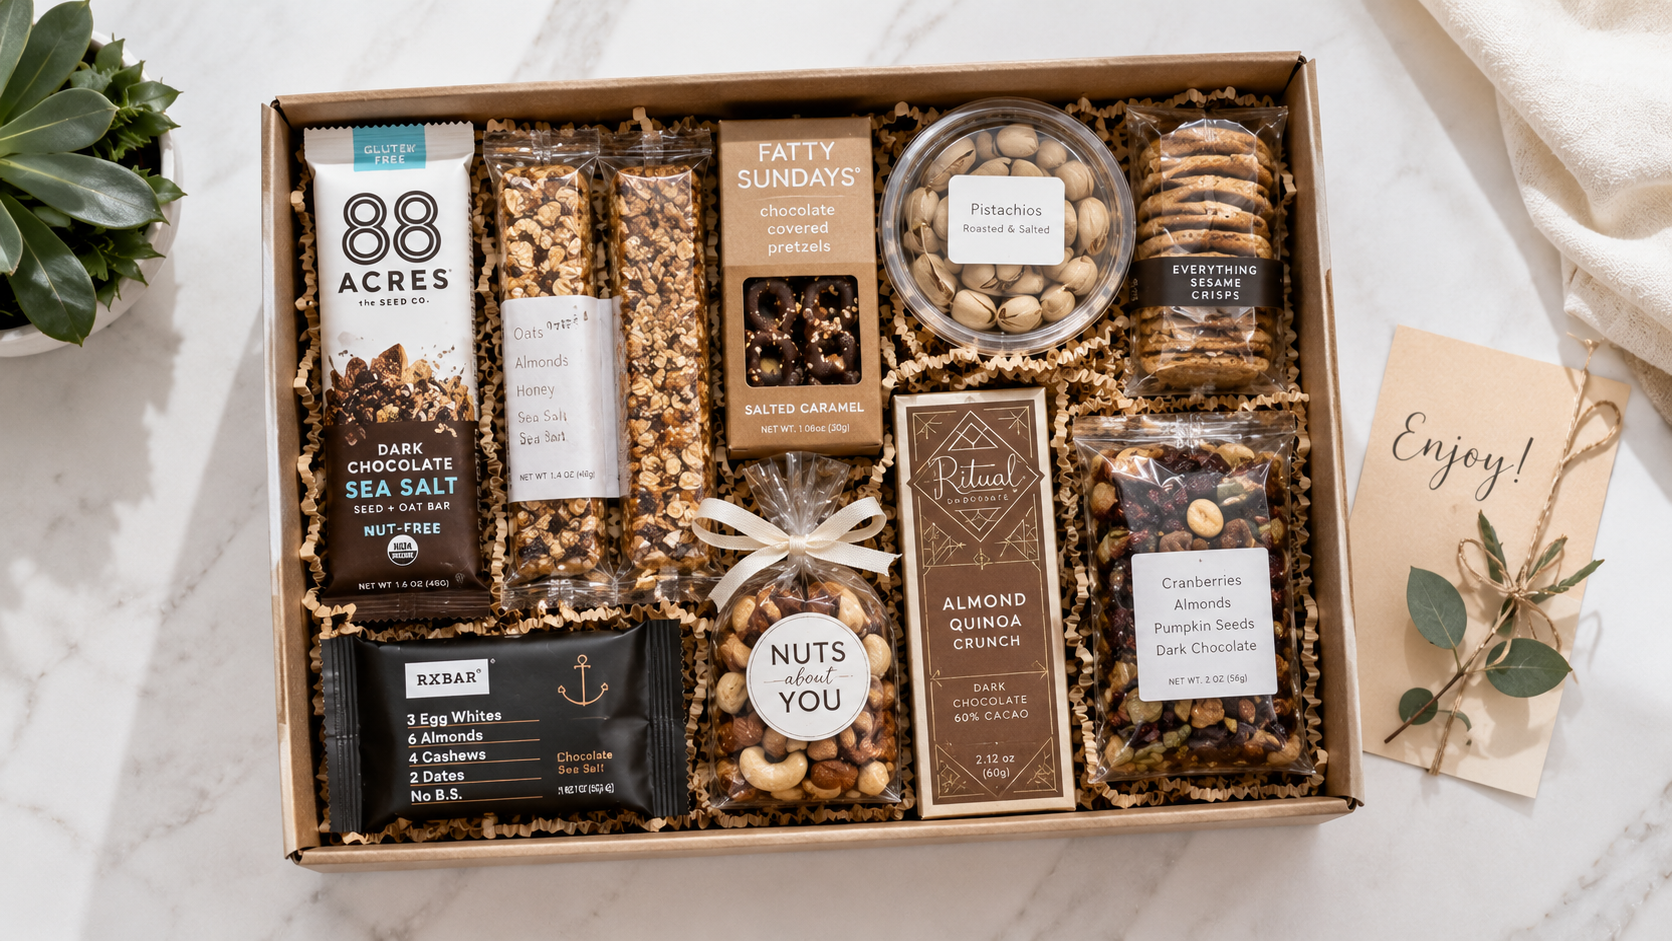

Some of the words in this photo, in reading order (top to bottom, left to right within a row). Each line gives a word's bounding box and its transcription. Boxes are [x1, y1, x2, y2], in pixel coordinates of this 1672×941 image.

[759, 141, 835, 162] FATTY
[375, 155, 405, 165] FREE
[760, 204, 835, 217] chocolate
[971, 203, 1042, 216] Pistachios
[342, 190, 442, 266] 88
[768, 221, 829, 235] covered
[963, 224, 1004, 233] Roasted
[1007, 225, 1015, 233] &
[1019, 225, 1050, 234] Salted
[768, 239, 831, 257] pretzels
[1172, 265, 1257, 275] EVERYTHING
[338, 268, 449, 294] ACRES
[1190, 278, 1241, 288] SESAME
[380, 298, 407, 307] SEED
[412, 297, 430, 305] CO.
[1191, 291, 1240, 300] CRISPS
[514, 327, 544, 341] Oats
[515, 353, 569, 369] Almonds
[516, 384, 555, 399] Honey
[745, 404, 796, 416] SALTED
[800, 402, 865, 414] CARAMEL
[518, 411, 539, 423] Sea
[761, 425, 778, 434] NET
[780, 424, 797, 433] WT.
[520, 432, 540, 445] Sea
[378, 442, 423, 456] DARK
[1392, 411, 1534, 502] Enjoy!
[347, 457, 453, 474] CHOCOLATE
[520, 473, 533, 481] NET
[536, 472, 548, 480] WT
[930, 453, 1026, 500] Ritual
[345, 479, 392, 499] SEA
[400, 476, 458, 497] SALT
[354, 505, 384, 514] SEED
[399, 502, 422, 512] OAT
[427, 501, 450, 511] BAR
[363, 522, 441, 537] NUT-FREE
[358, 582, 375, 590] NET
[378, 581, 392, 589] WT
[1161, 575, 1242, 589] Cranberries
[943, 592, 1026, 611] ALMOND
[1174, 596, 1232, 611] Almonds
[950, 614, 1022, 632] QUINOA
[1154, 620, 1211, 636] Pumpkin
[1216, 618, 1255, 631] Seeds
[953, 635, 1020, 650] CRUNCH
[1156, 643, 1187, 656] Dark
[1191, 640, 1257, 654] Chocolate
[771, 641, 846, 666] NUTS
[416, 671, 477, 686] RXBAR
[784, 666, 837, 687] about
[1168, 676, 1185, 686] NET
[1188, 676, 1203, 685] WT.
[1205, 675, 1210, 684] 2
[1212, 674, 1225, 683] OZ
[1227, 674, 1248, 684] (56g)
[974, 682, 1006, 693] DARK
[778, 688, 840, 713] YOU
[953, 695, 1028, 709] CHOCOLATE
[407, 714, 415, 725] 3
[420, 712, 448, 727] Egg
[451, 709, 502, 723] Whites
[954, 711, 980, 723] 60%
[984, 709, 1029, 722] CACAO
[407, 733, 417, 745] 6
[421, 729, 483, 745] Almonds
[408, 753, 418, 764] 4
[422, 750, 487, 764] Cashews
[557, 750, 613, 762] Chocolate
[976, 754, 999, 765] 2.12
[1002, 754, 1015, 763] oz
[410, 772, 419, 784] 2
[423, 769, 465, 783] Dates
[982, 767, 1010, 780] (60g)
[411, 790, 431, 803] No
[435, 788, 463, 801] B.S.
